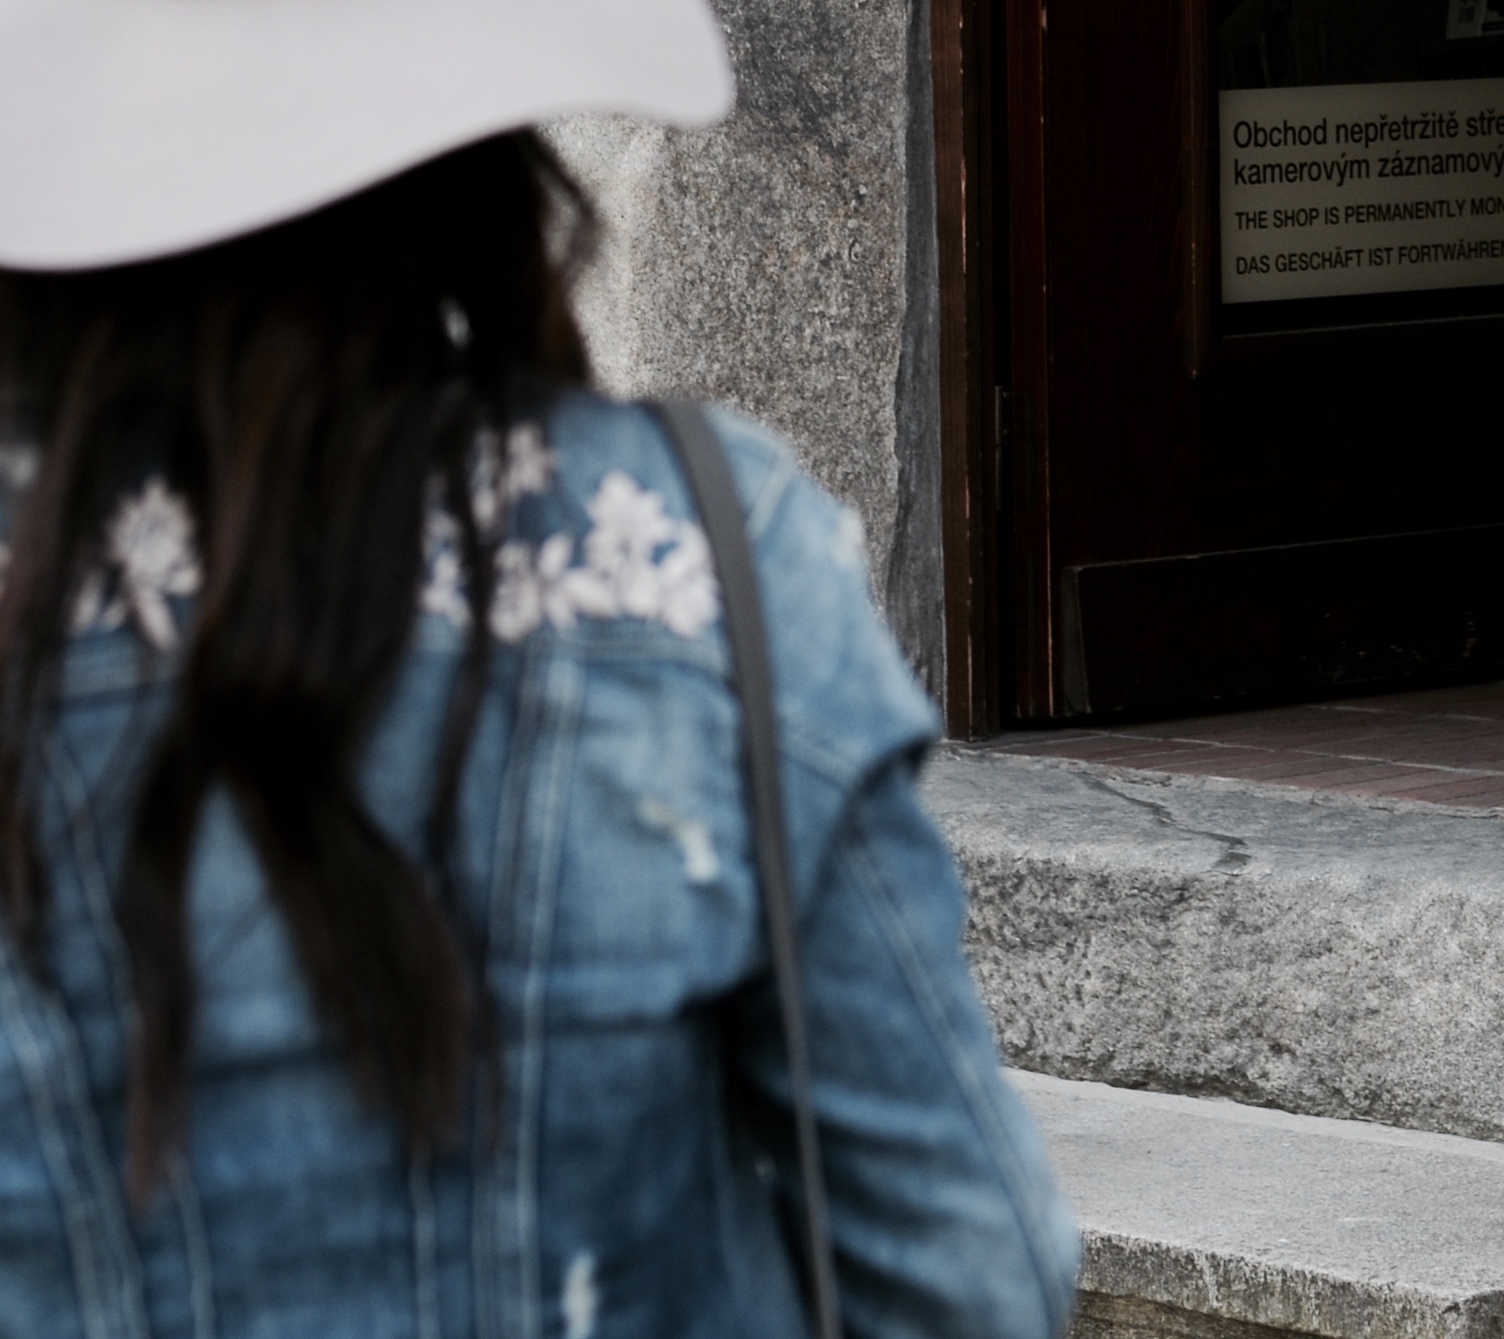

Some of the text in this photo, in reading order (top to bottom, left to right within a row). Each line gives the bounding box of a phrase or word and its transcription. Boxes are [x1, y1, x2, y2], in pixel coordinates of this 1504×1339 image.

[1233, 119, 1327, 148] Obchod
[1336, 111, 1458, 148] nepřetržitě
[1234, 154, 1370, 186] kamerovým
[1236, 211, 1268, 230] THE
[1273, 209, 1318, 228] SHOP
[1325, 207, 1339, 225] IS
[1345, 200, 1465, 224] PERMANENTLY
[1236, 256, 1269, 275] DAS
[1275, 249, 1363, 273] GESCHÄFT
[1369, 247, 1393, 266] IST
